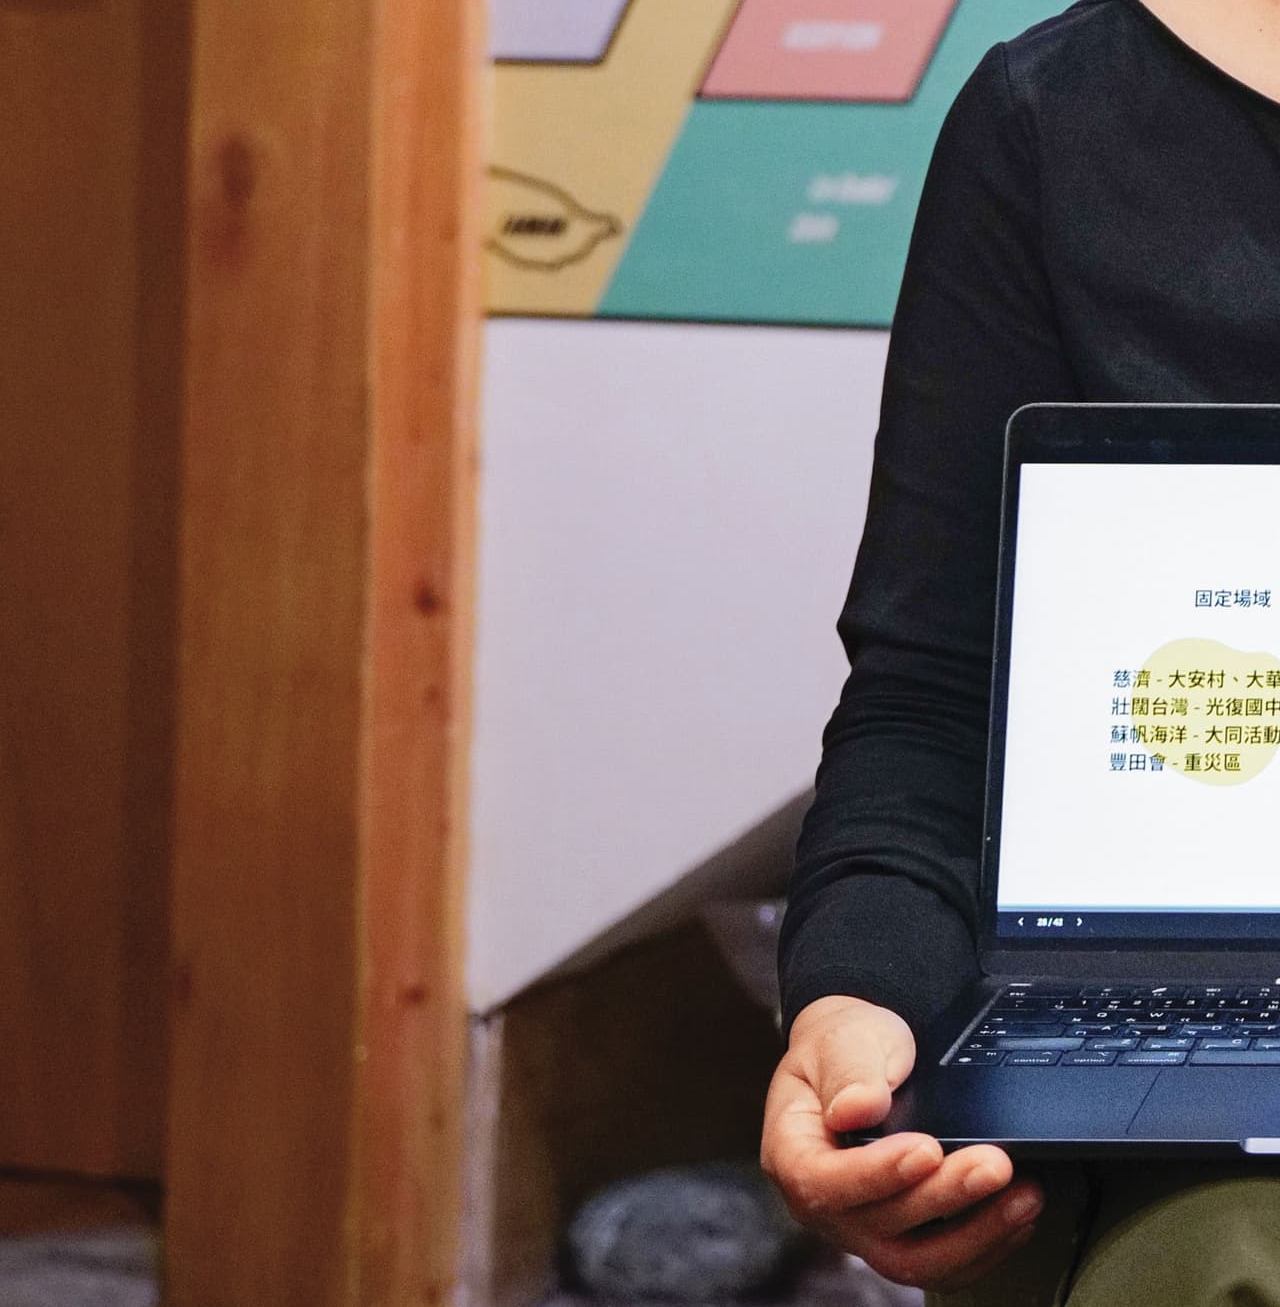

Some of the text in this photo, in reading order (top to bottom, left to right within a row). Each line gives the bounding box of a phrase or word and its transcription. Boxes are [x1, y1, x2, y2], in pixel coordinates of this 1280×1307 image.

[1194, 589, 1271, 608] 固定場域
[1113, 669, 1151, 688] 慈濟
[1111, 696, 1188, 716] 壯闊台灣
[1110, 724, 1187, 744] 蘇帆海洋
[1110, 752, 1166, 772] 豐田會
[1184, 752, 1241, 772] 重災區
